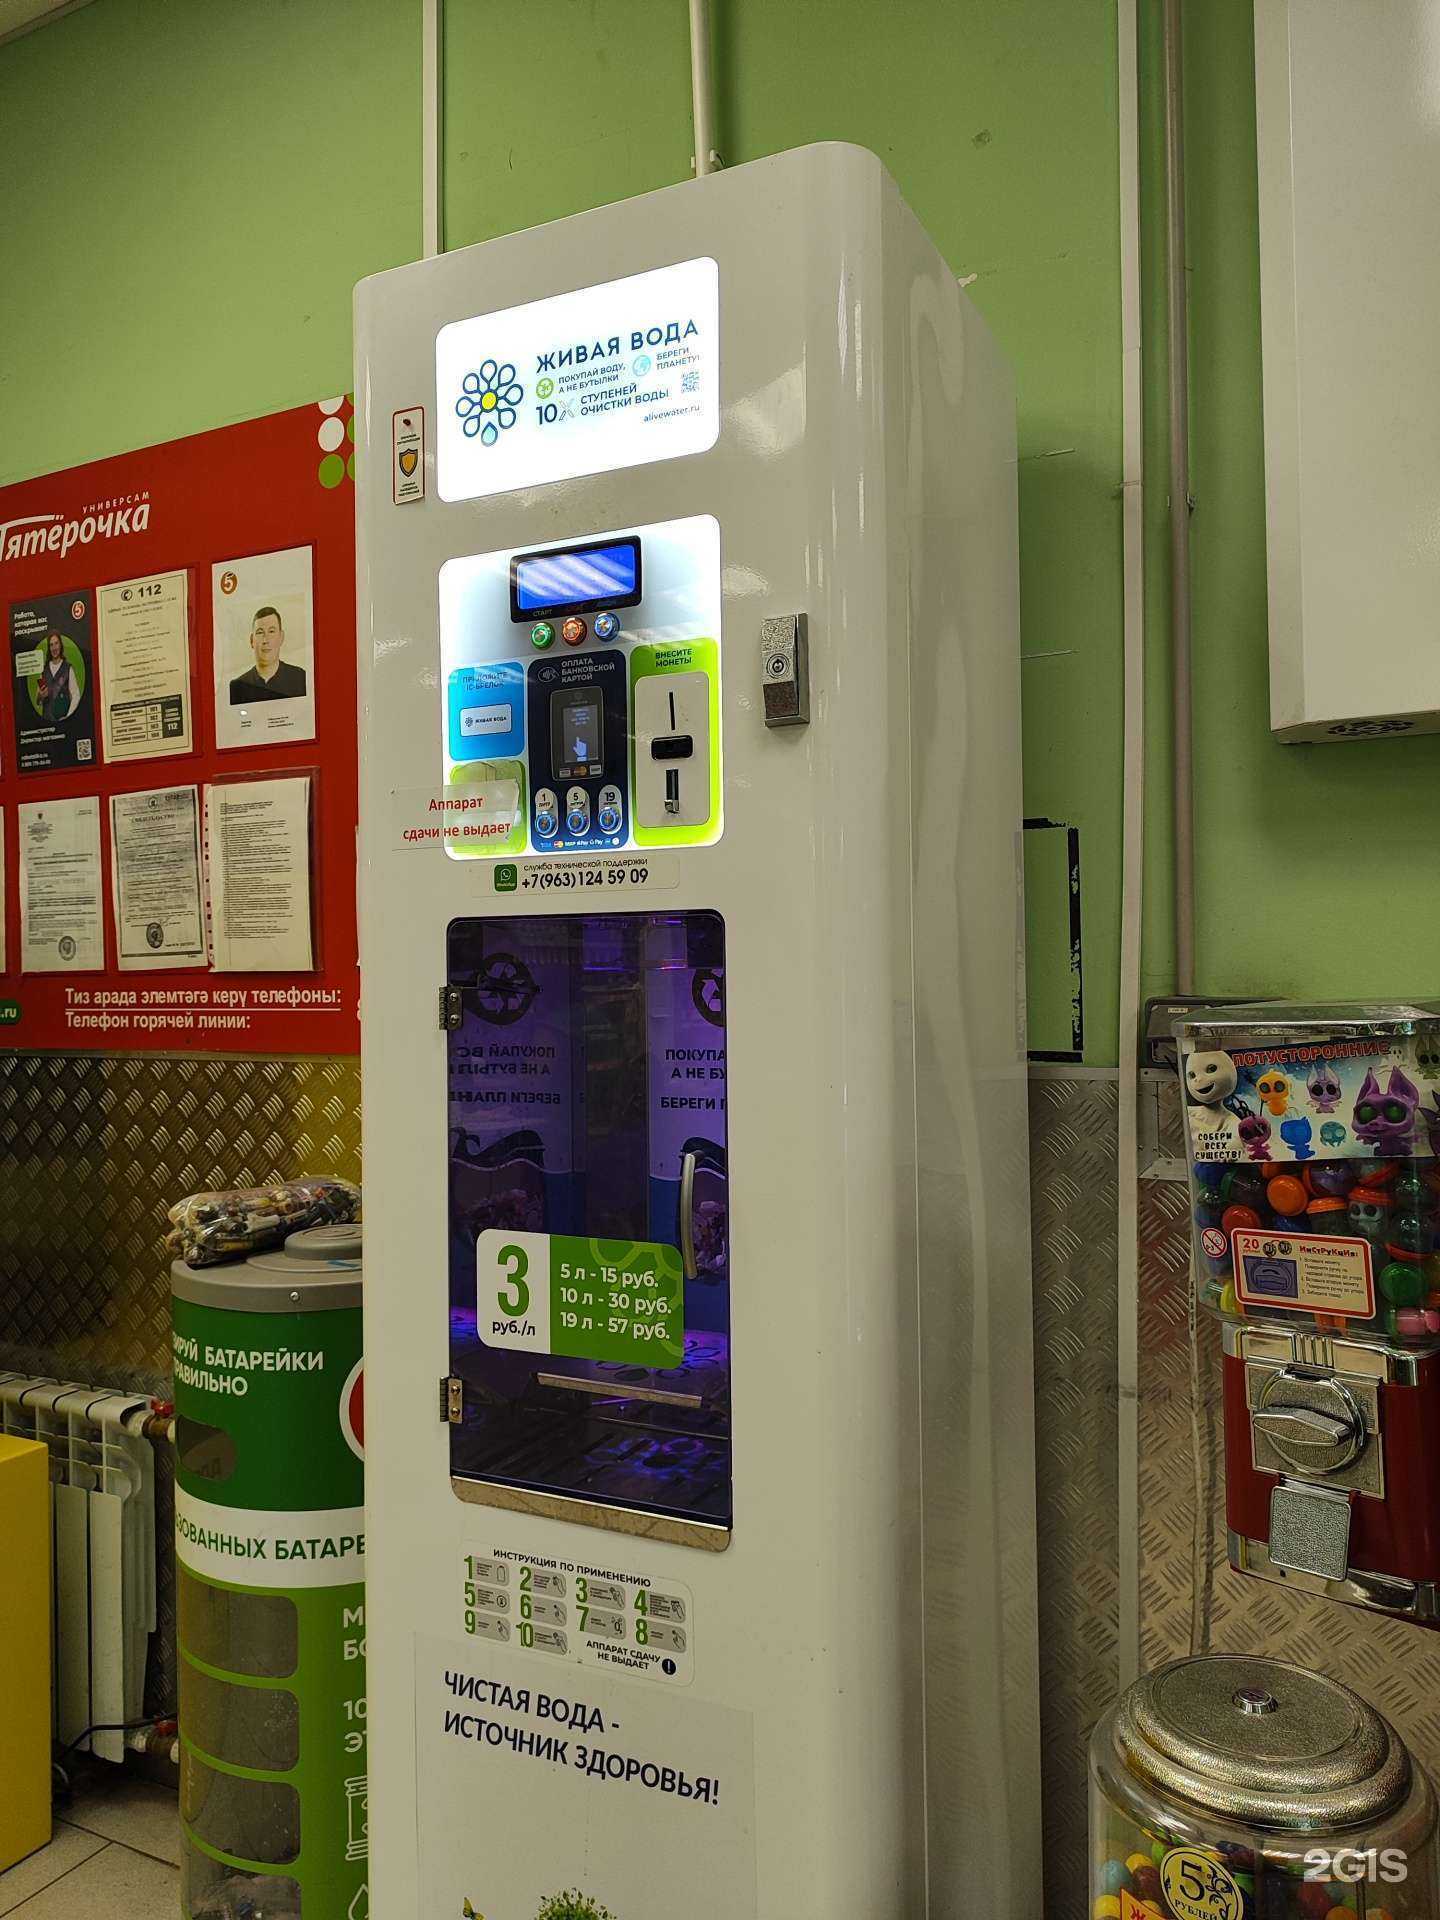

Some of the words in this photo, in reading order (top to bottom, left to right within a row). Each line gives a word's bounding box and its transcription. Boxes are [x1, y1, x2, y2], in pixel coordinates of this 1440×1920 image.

[536, 336, 620, 374] ЖИВАЯ
[631, 319, 699, 351] ВОДА
[656, 347, 689, 361] БЕРЕГИ
[558, 367, 598, 384] ПОКУПАЙ
[600, 362, 626, 376] ВОДУ,
[566, 384, 578, 393] НЕ
[579, 374, 619, 389] БУТЫЛКИ
[580, 396, 632, 416] ОЧИСТКИ
[635, 389, 669, 404] ВОДЫ
[581, 383, 637, 405] СТУПЕНЕЙ
[535, 403, 558, 425] 10
[643, 405, 700, 423] alivewater.ru
[82, 491, 150, 514] УНИВЕРСАМ
[138, 584, 162, 598] 112
[561, 658, 594, 668] ОПЛАТА
[655, 648, 693, 659] ВНЕСИТЕ
[655, 657, 692, 668] МОНЕТЫ
[561, 662, 615, 676] БАНКОВСКОЙ
[561, 672, 593, 683] КАРТОЙ
[429, 797, 484, 812] Аппарат
[573, 793, 579, 801] 5
[605, 792, 615, 801] 19
[403, 827, 443, 842] сдачи
[444, 826, 460, 837] не
[463, 822, 511, 839] выдает
[524, 862, 552, 872] служба
[554, 860, 600, 870] технической
[602, 858, 648, 868] поддержки
[608, 869, 626, 884] 59
[630, 868, 649, 884] 09
[65, 988, 90, 1004] Тиз
[94, 990, 137, 1007] арада
[141, 990, 209, 1005] элемтәгә
[213, 989, 248, 1007] керү
[251, 985, 341, 1007] телефоны:
[65, 1011, 130, 1031] Телефон
[133, 1010, 194, 1032] горячей
[197, 1014, 251, 1029] линии:
[1232, 1040, 1391, 1067] ПОТУСТОРОННИЕ
[671, 1068, 682, 1079] А
[686, 1068, 705, 1079] НЕ
[660, 1096, 716, 1110] БЕРЕГИ
[1198, 1132, 1233, 1142] СОБЕРИ
[1204, 1141, 1227, 1150] ВСЕХ
[1243, 1238, 1260, 1250] 20
[497, 1244, 530, 1317] 3
[560, 1263, 571, 1279] 5
[574, 1267, 586, 1281] л
[600, 1267, 617, 1284] 15
[622, 1270, 659, 1288] руб.
[560, 1287, 578, 1304] 10
[581, 1291, 593, 1305] л
[608, 1292, 630, 1310] 30
[634, 1296, 672, 1315] руб.
[492, 1320, 536, 1336] руб./л
[560, 1311, 578, 1329] 19
[581, 1316, 593, 1330] л
[608, 1316, 629, 1334] 57
[633, 1321, 671, 1341] руб.
[205, 1346, 325, 1372] БАТАРЕЙКИ
[275, 1534, 365, 1560] БАТАРЕ
[464, 1555, 473, 1580] 1
[493, 1548, 557, 1569] ИНСТРУКЦИЯ
[560, 1562, 574, 1572] ПО
[577, 1565, 651, 1588] ПРИМЕНЕНИЮ
[519, 1566, 532, 1592] 2
[575, 1577, 588, 1603] 3
[464, 1581, 476, 1607] 5
[634, 1589, 648, 1616] 4
[520, 1594, 532, 1619] 6
[464, 1610, 476, 1634] 9
[575, 1604, 590, 1632] 7
[515, 1621, 534, 1648] 10
[635, 1618, 649, 1646] 8
[586, 1640, 629, 1656] АППАРАТ
[630, 1649, 661, 1663] СДАЧУ
[597, 1652, 610, 1661] НЕ
[611, 1654, 650, 1670] ВЫДАЕТ
[444, 1670, 530, 1714] ЧИСТАЯ
[536, 1693, 605, 1734] ВОДА
[444, 1710, 569, 1765] ИСТОЧНИК
[574, 1744, 719, 1806] ЗДОРОВЬЯ!
[1180, 1860, 1205, 1901] 5
